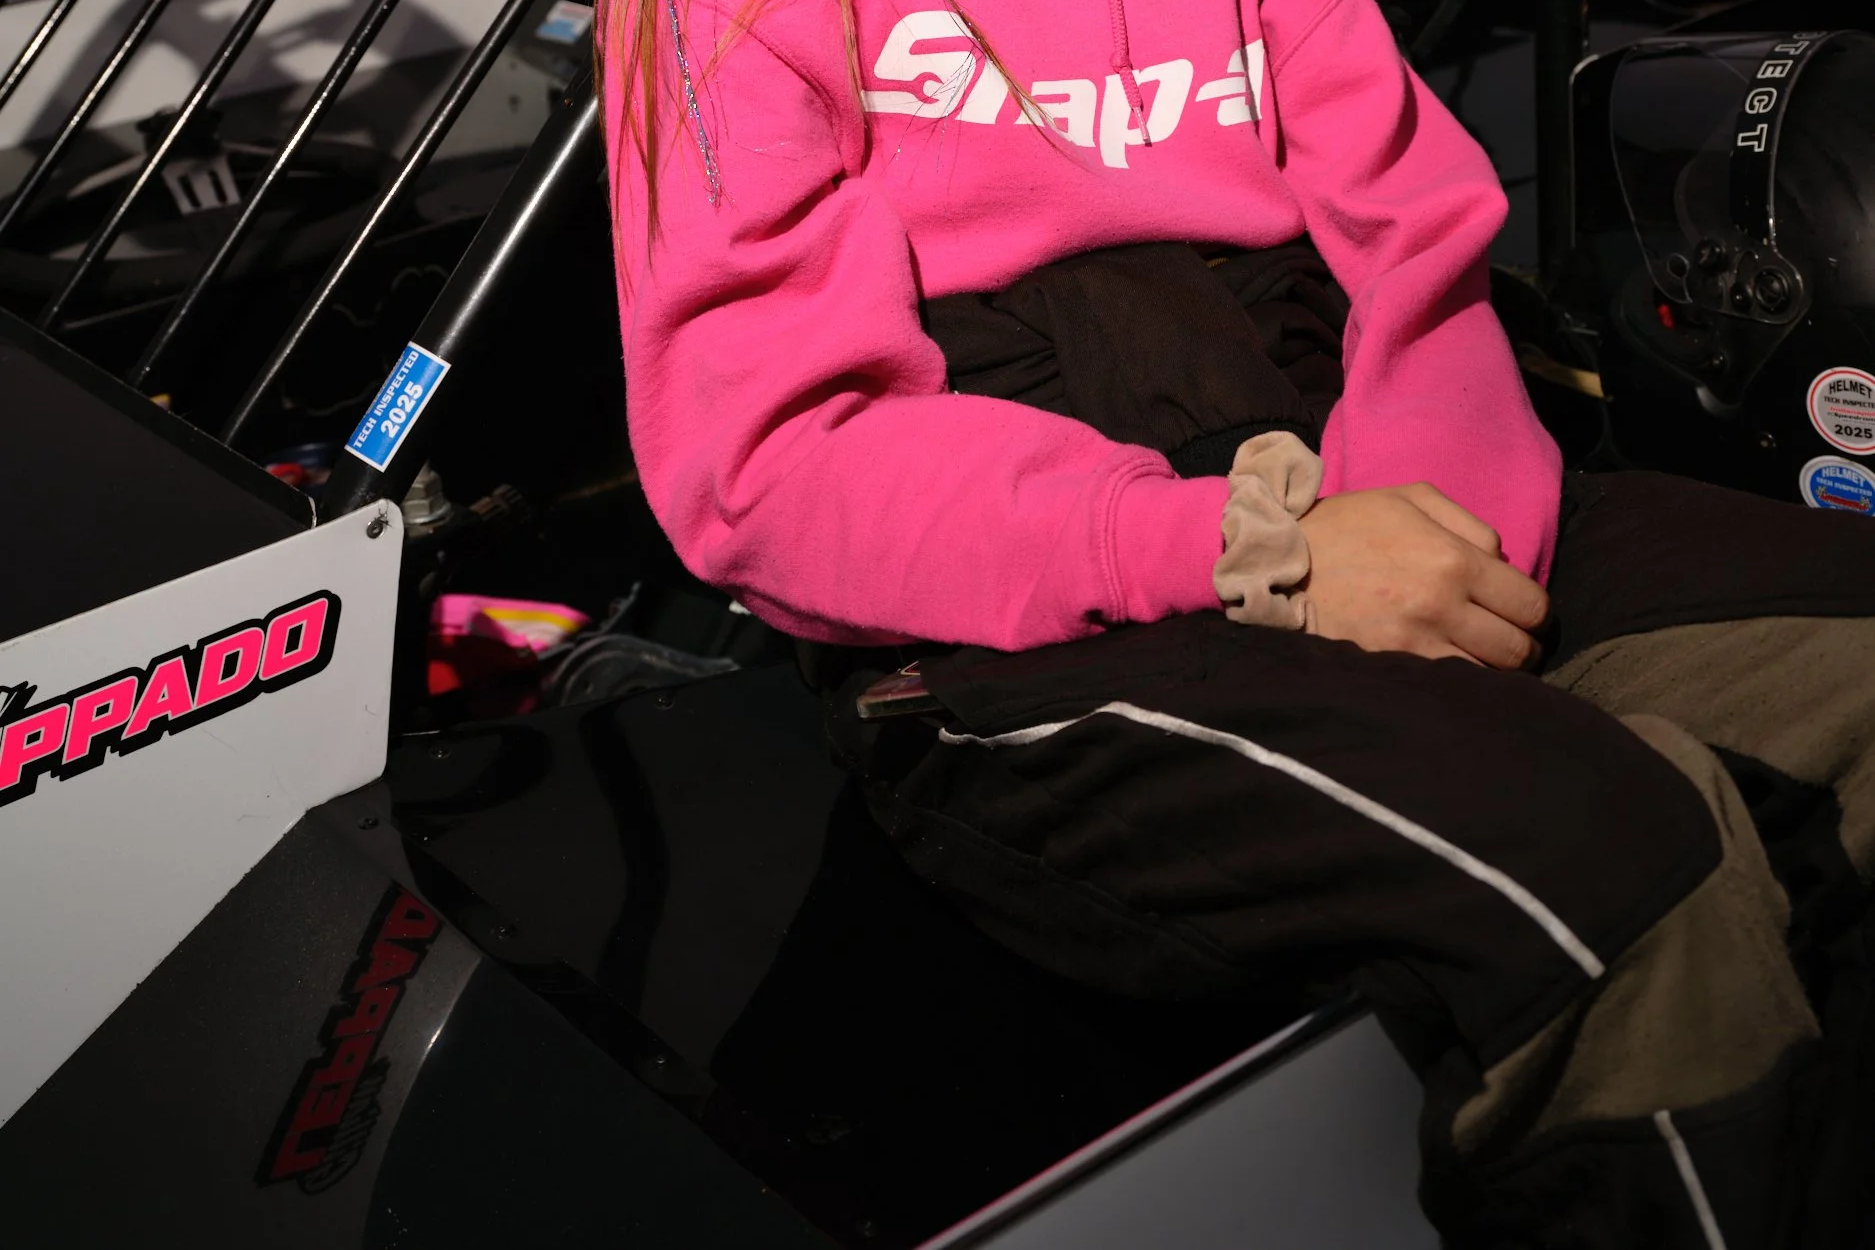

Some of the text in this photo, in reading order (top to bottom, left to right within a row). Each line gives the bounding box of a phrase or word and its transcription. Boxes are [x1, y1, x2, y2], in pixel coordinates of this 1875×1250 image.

[353, 350, 419, 448] TECH INSPECTED
[1829, 380, 1872, 398] HELMET
[380, 381, 423, 439] 2025
[1835, 424, 1873, 439] 2025
[1821, 466, 1867, 488] HELMET
[0, 598, 330, 792] PPADO
